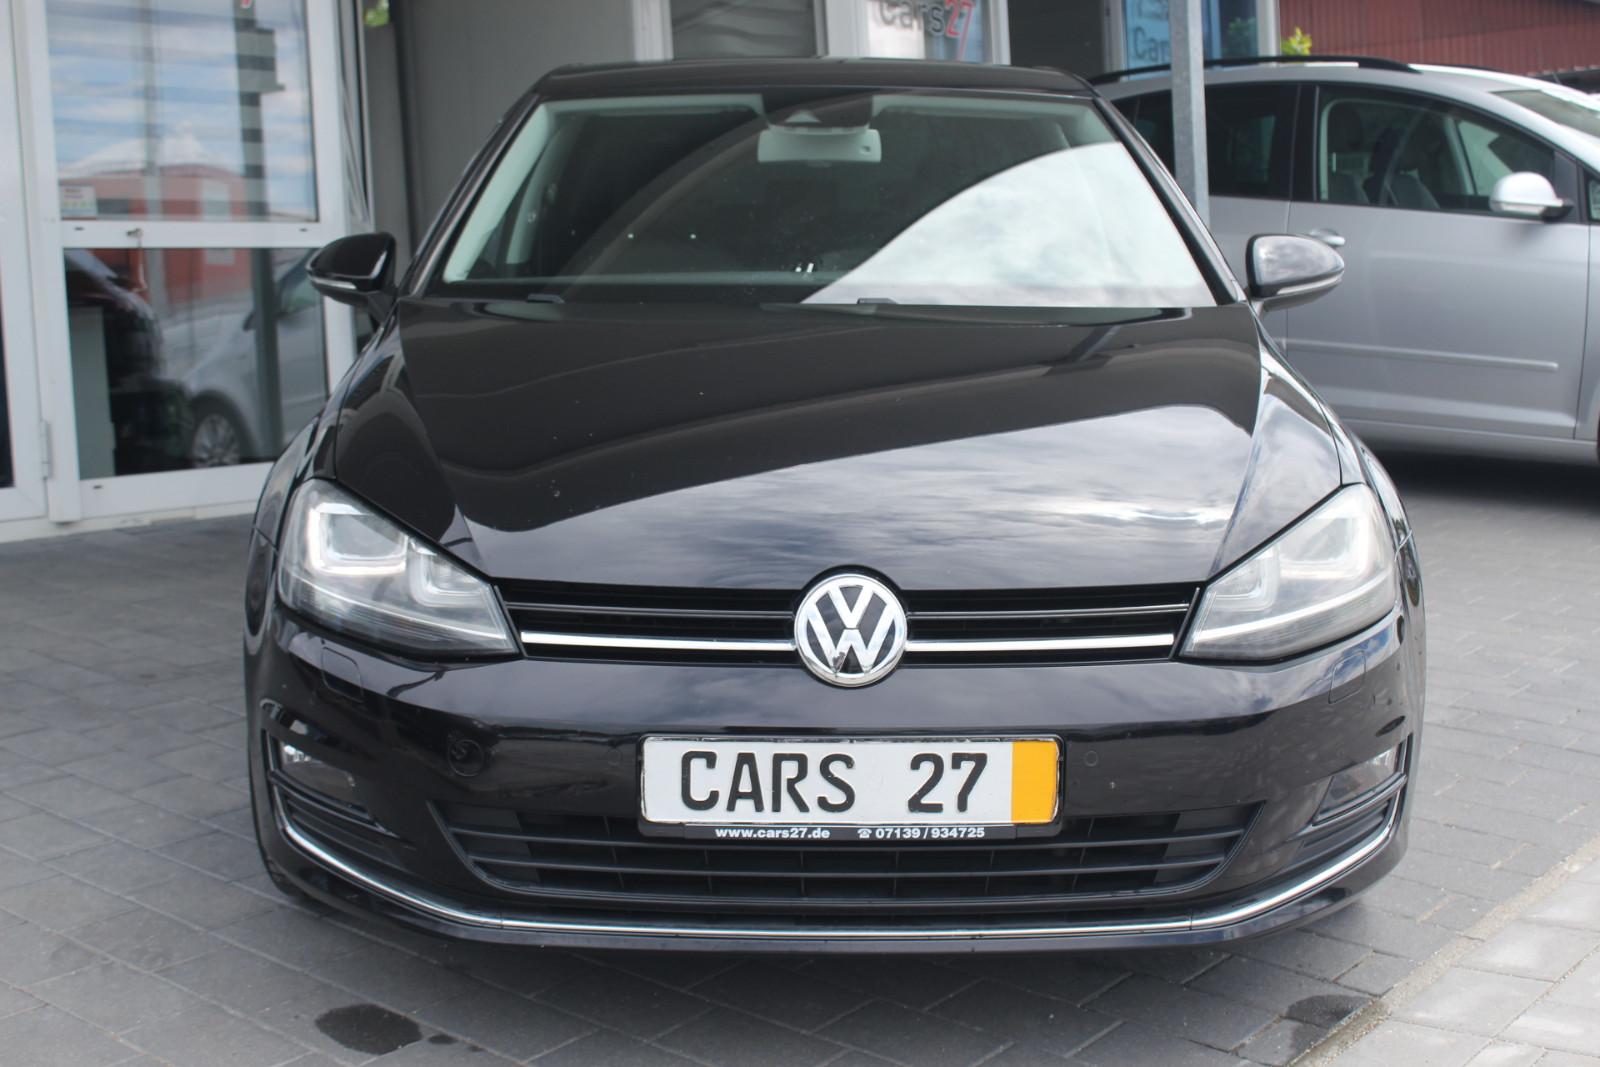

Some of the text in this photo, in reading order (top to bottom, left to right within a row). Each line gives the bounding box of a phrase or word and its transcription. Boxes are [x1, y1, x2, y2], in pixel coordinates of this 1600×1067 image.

[681, 750, 988, 813] CARS 27
[715, 827, 831, 839] www.cars27.de
